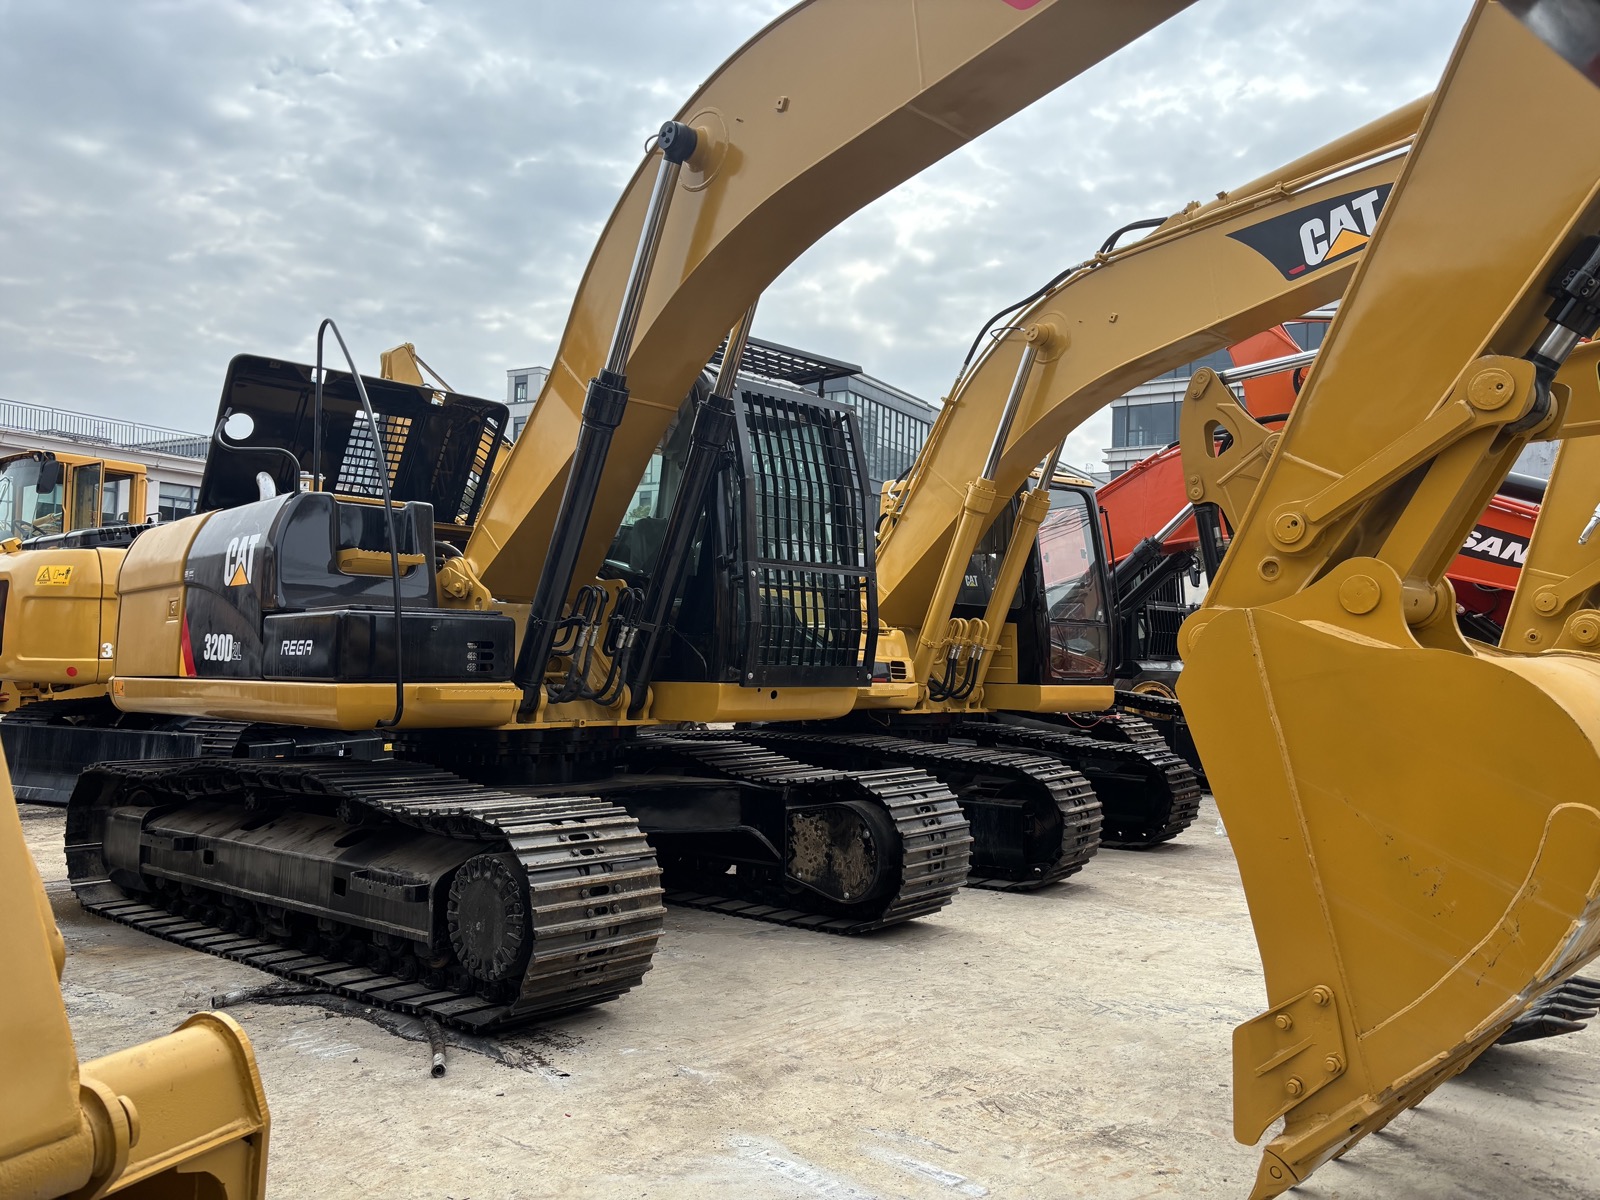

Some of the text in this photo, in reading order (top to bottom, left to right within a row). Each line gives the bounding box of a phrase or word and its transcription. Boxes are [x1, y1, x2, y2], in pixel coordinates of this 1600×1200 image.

[1299, 189, 1379, 266] CAT
[223, 533, 262, 587] CAT
[964, 575, 979, 587] CAT
[280, 639, 313, 656] REGA
